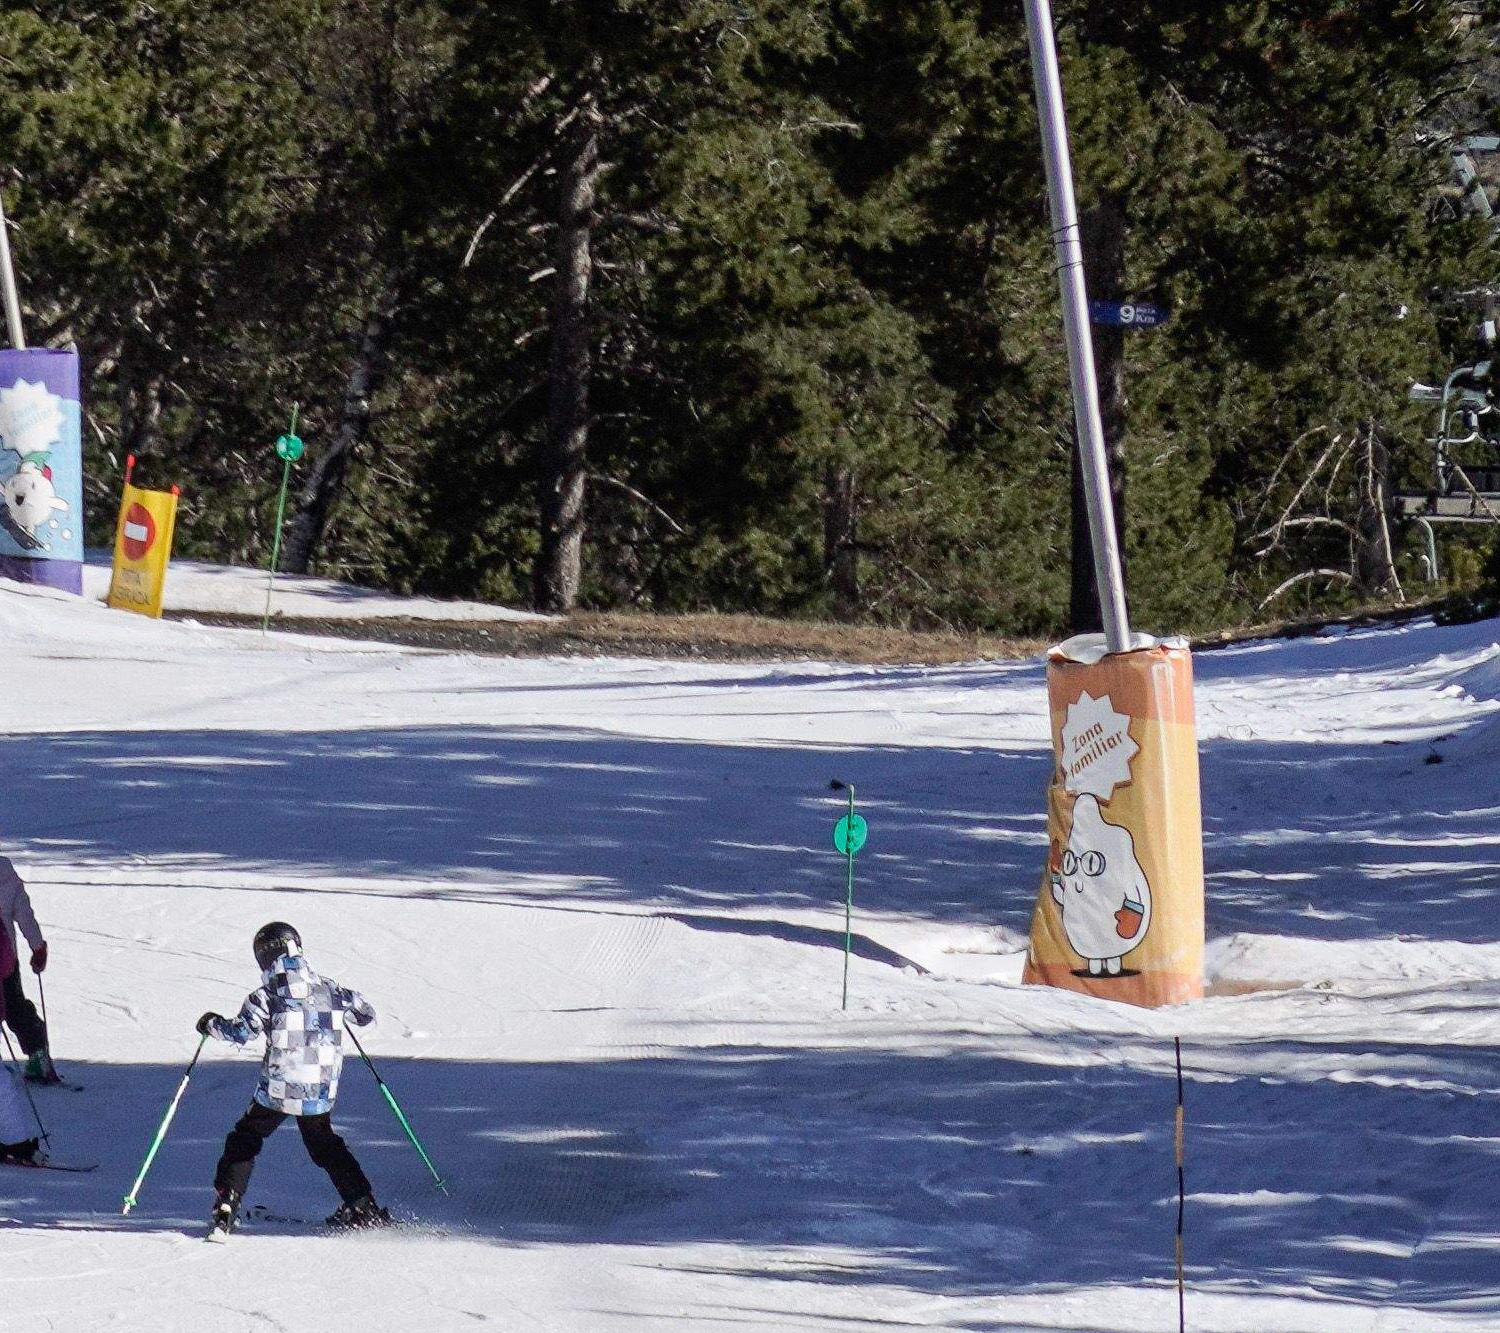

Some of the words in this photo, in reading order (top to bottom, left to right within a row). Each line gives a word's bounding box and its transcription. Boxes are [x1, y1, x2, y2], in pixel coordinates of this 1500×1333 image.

[1120, 304, 1135, 323] 9
[1071, 722, 1103, 753] Zona
[1070, 730, 1123, 778] familiar
